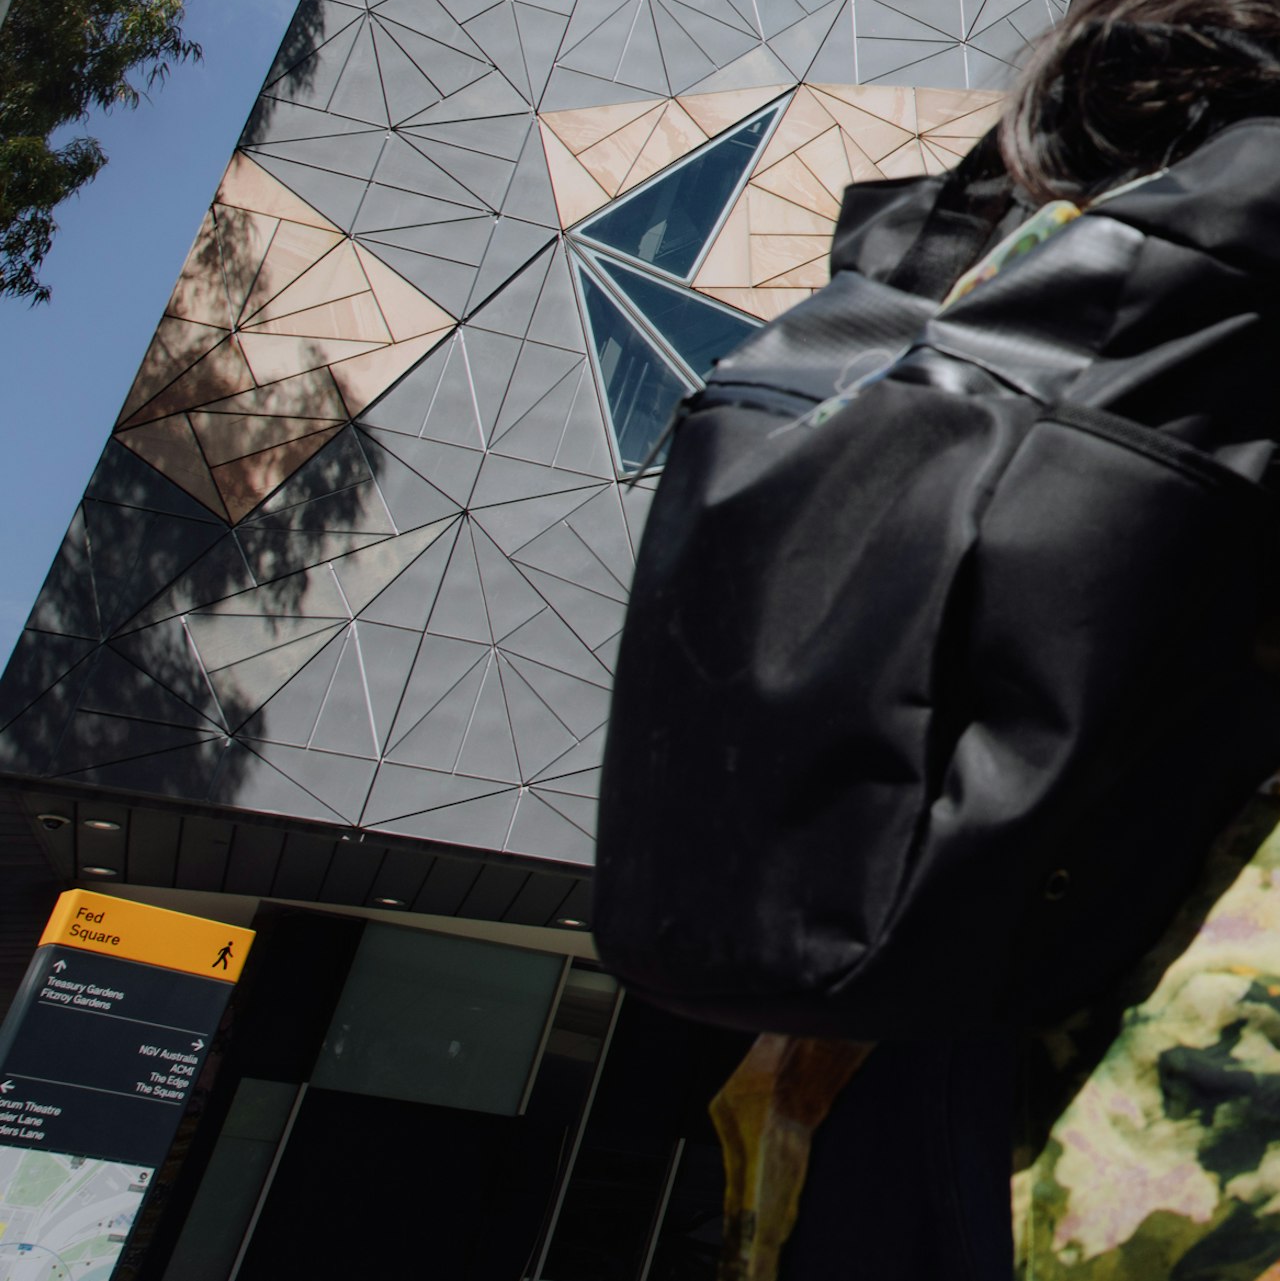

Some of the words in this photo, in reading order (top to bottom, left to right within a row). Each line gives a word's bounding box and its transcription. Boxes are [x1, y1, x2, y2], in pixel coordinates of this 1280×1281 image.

[76, 907, 105, 924] Fed
[69, 924, 120, 946] Square
[47, 976, 86, 993] Treasury
[87, 984, 124, 1000] Gardens
[40, 988, 73, 1004] Fitzroy
[73, 994, 111, 1010] Gardens
[139, 1045, 161, 1056] NGV
[160, 1049, 198, 1064] Australia
[170, 1064, 195, 1076] ACMI
[150, 1072, 167, 1083] The
[167, 1075, 189, 1089] Edge
[136, 1082, 152, 1093] The
[152, 1086, 185, 1099] Square
[0, 1098, 24, 1110] orum
[25, 1101, 62, 1116] Theatre
[0, 1111, 19, 1122] sier
[17, 1114, 43, 1126] Lane
[0, 1124, 20, 1136] ders
[19, 1128, 45, 1140] Lane
